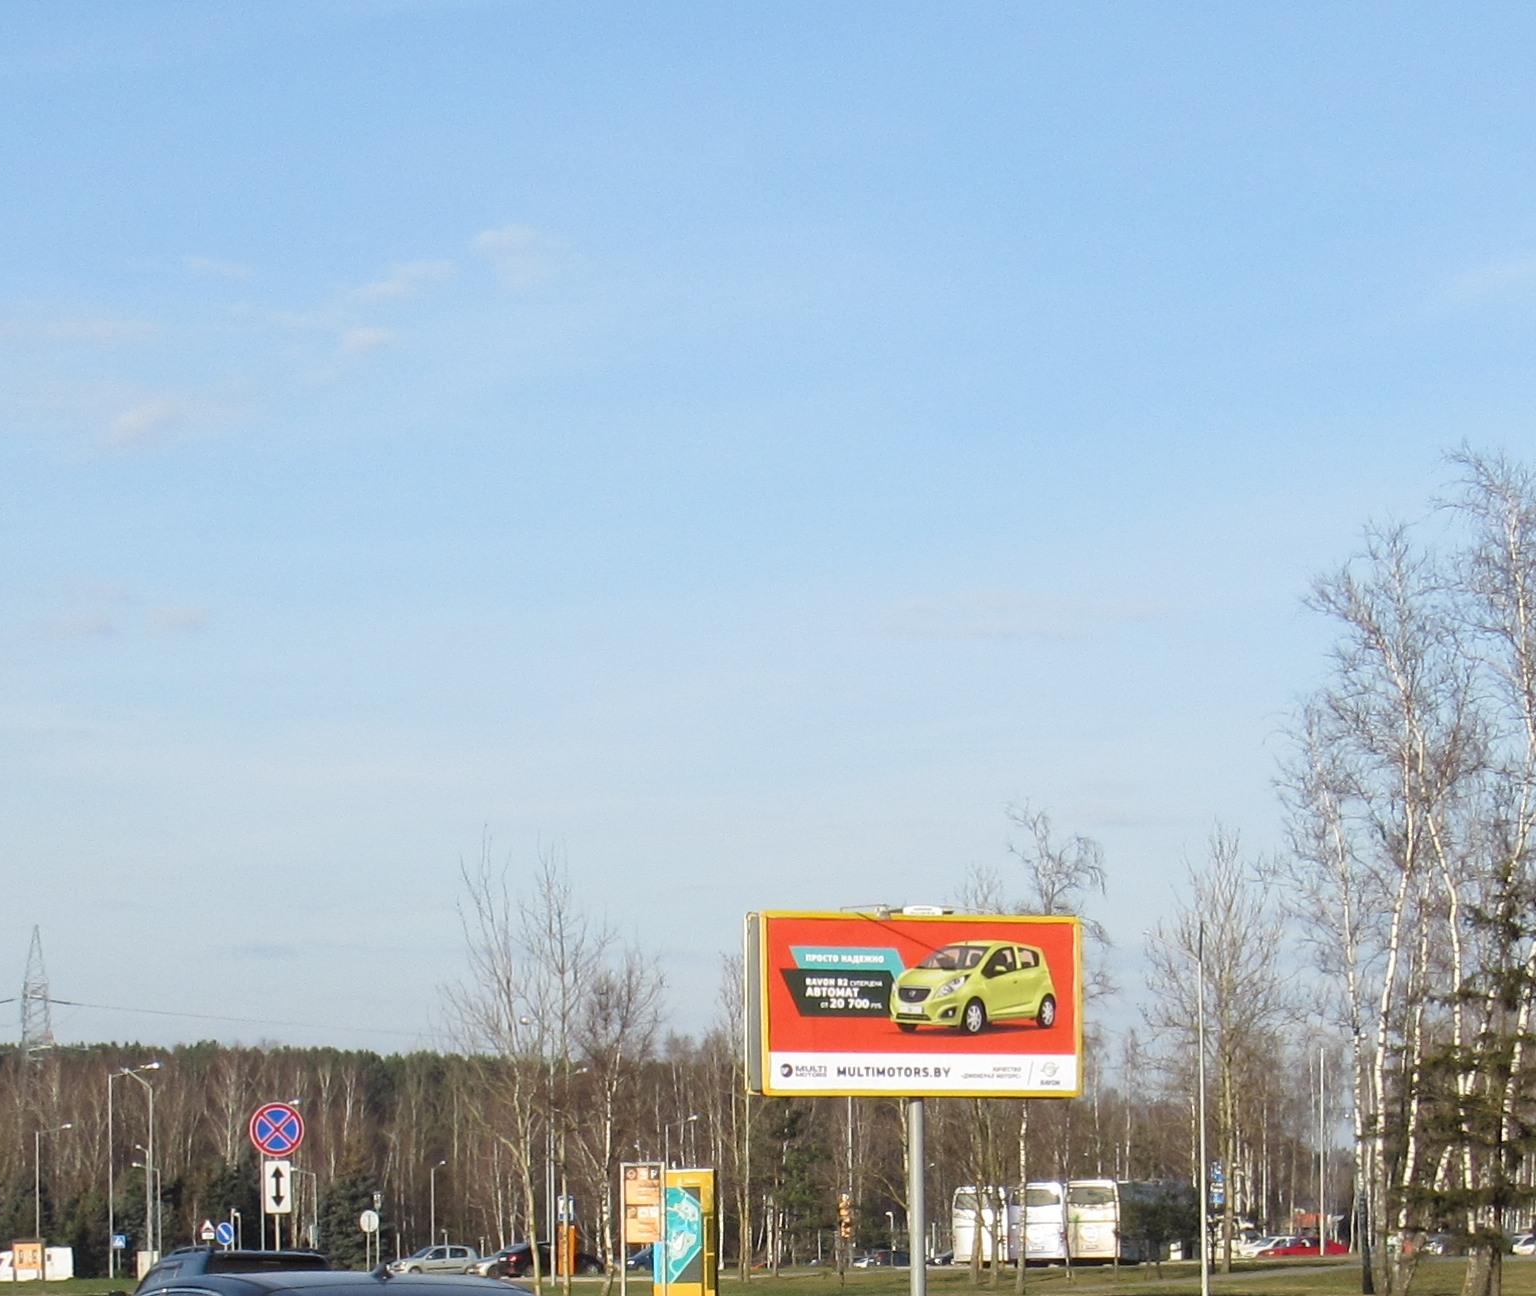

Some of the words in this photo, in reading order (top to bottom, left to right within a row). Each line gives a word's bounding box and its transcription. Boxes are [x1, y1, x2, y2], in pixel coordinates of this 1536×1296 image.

[805, 954, 839, 963] ПРОСТО
[841, 955, 884, 964] НАДЕЖНО
[805, 977, 835, 986] RAVON
[837, 978, 848, 986] R2
[805, 987, 859, 997] АВТОМАТ
[829, 998, 844, 1009] 20
[847, 998, 870, 1009] 700
[837, 1066, 951, 1077] MULTIMOTORS.BY
